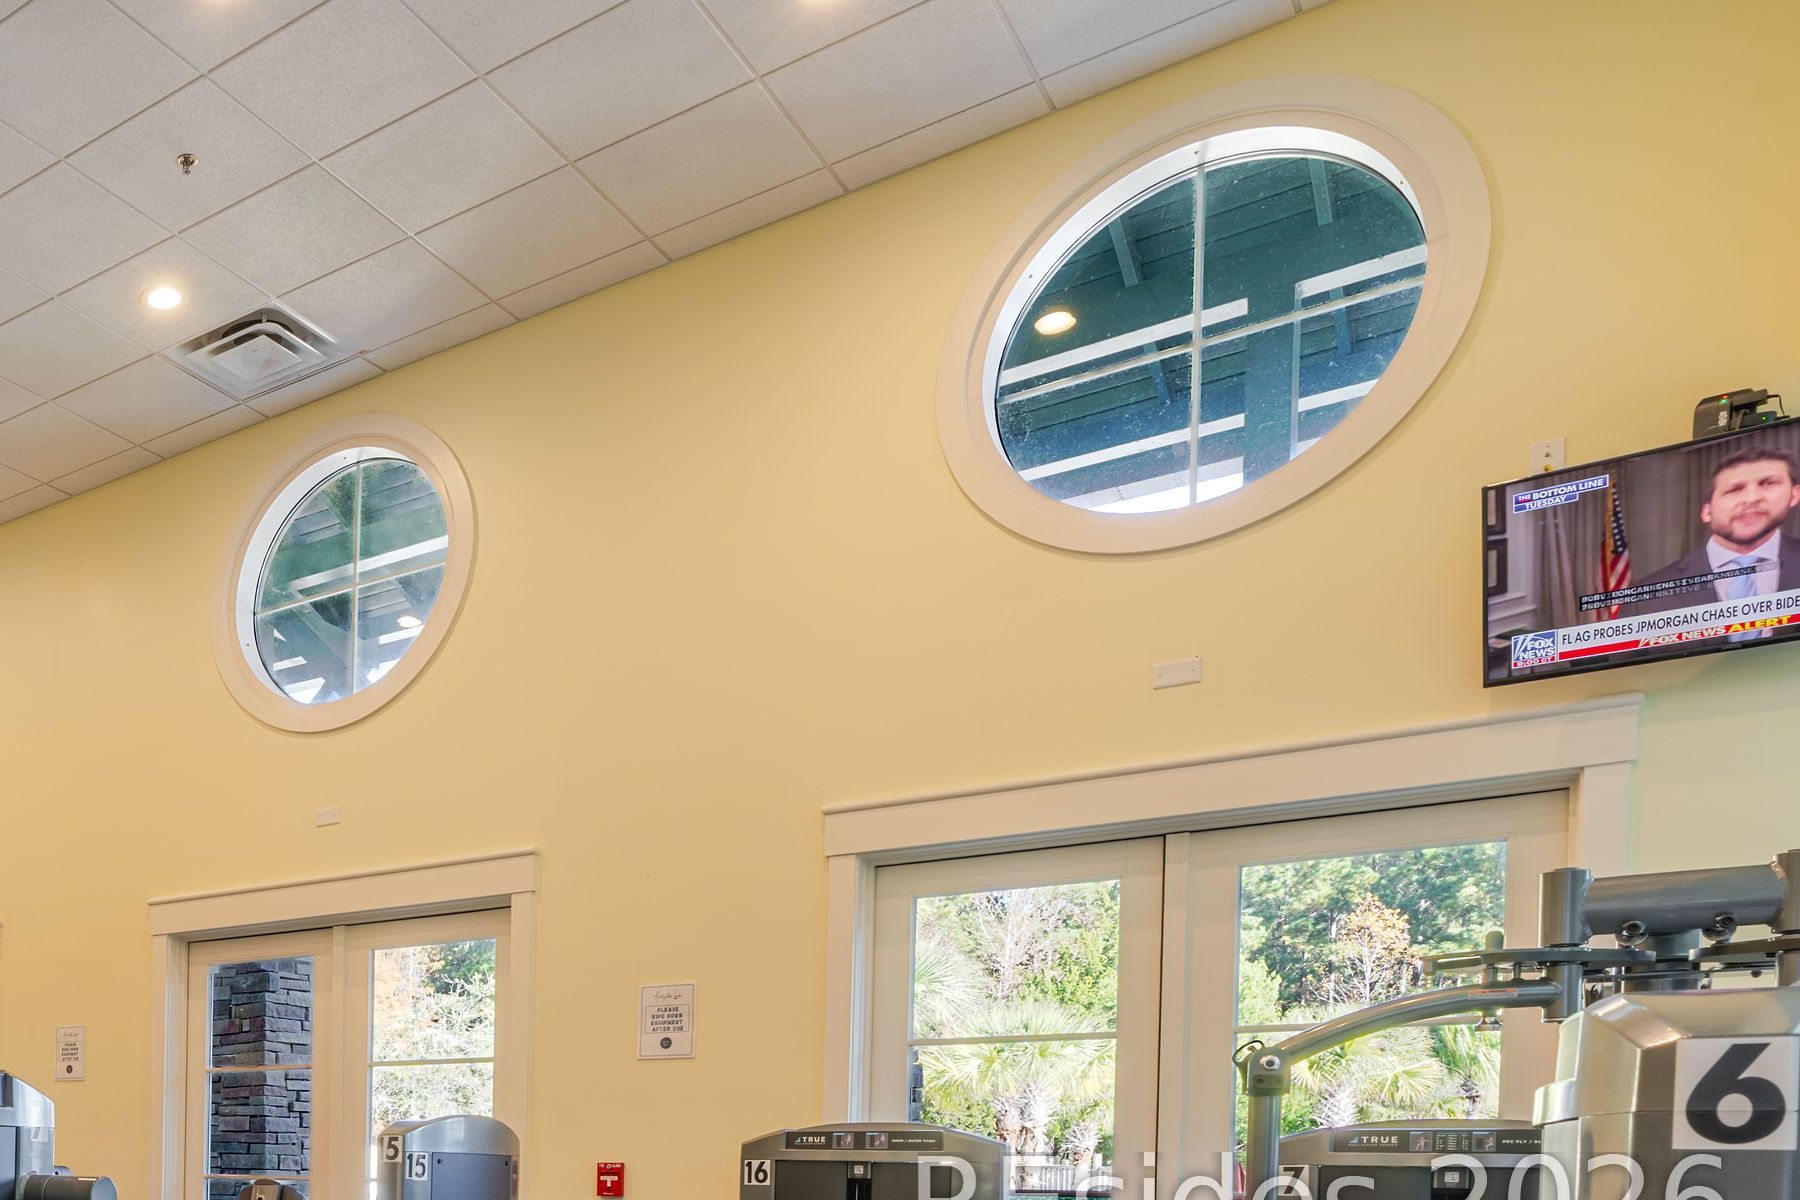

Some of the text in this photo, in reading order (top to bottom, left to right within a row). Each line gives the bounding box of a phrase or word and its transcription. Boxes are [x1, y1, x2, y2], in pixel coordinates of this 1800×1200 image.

[1533, 485, 1576, 500] BOTTOM
[1579, 478, 1604, 490] LINE
[1525, 495, 1567, 510] TUESDAY
[1562, 634, 1572, 645] FL
[1574, 630, 1590, 643] AG
[1593, 623, 1633, 640] PROBES
[1636, 612, 1699, 633] JPMORGAN
[1701, 605, 1738, 622] CHASE
[1742, 600, 1772, 616] OVER
[1648, 615, 1792, 646] FOX NEWS ALERT
[1520, 646, 1555, 660] NEWS
[1527, 638, 1554, 651] FOX
[1686, 1043, 1786, 1144] 6
[407, 1153, 426, 1178] 15
[745, 1161, 768, 1183] 16
